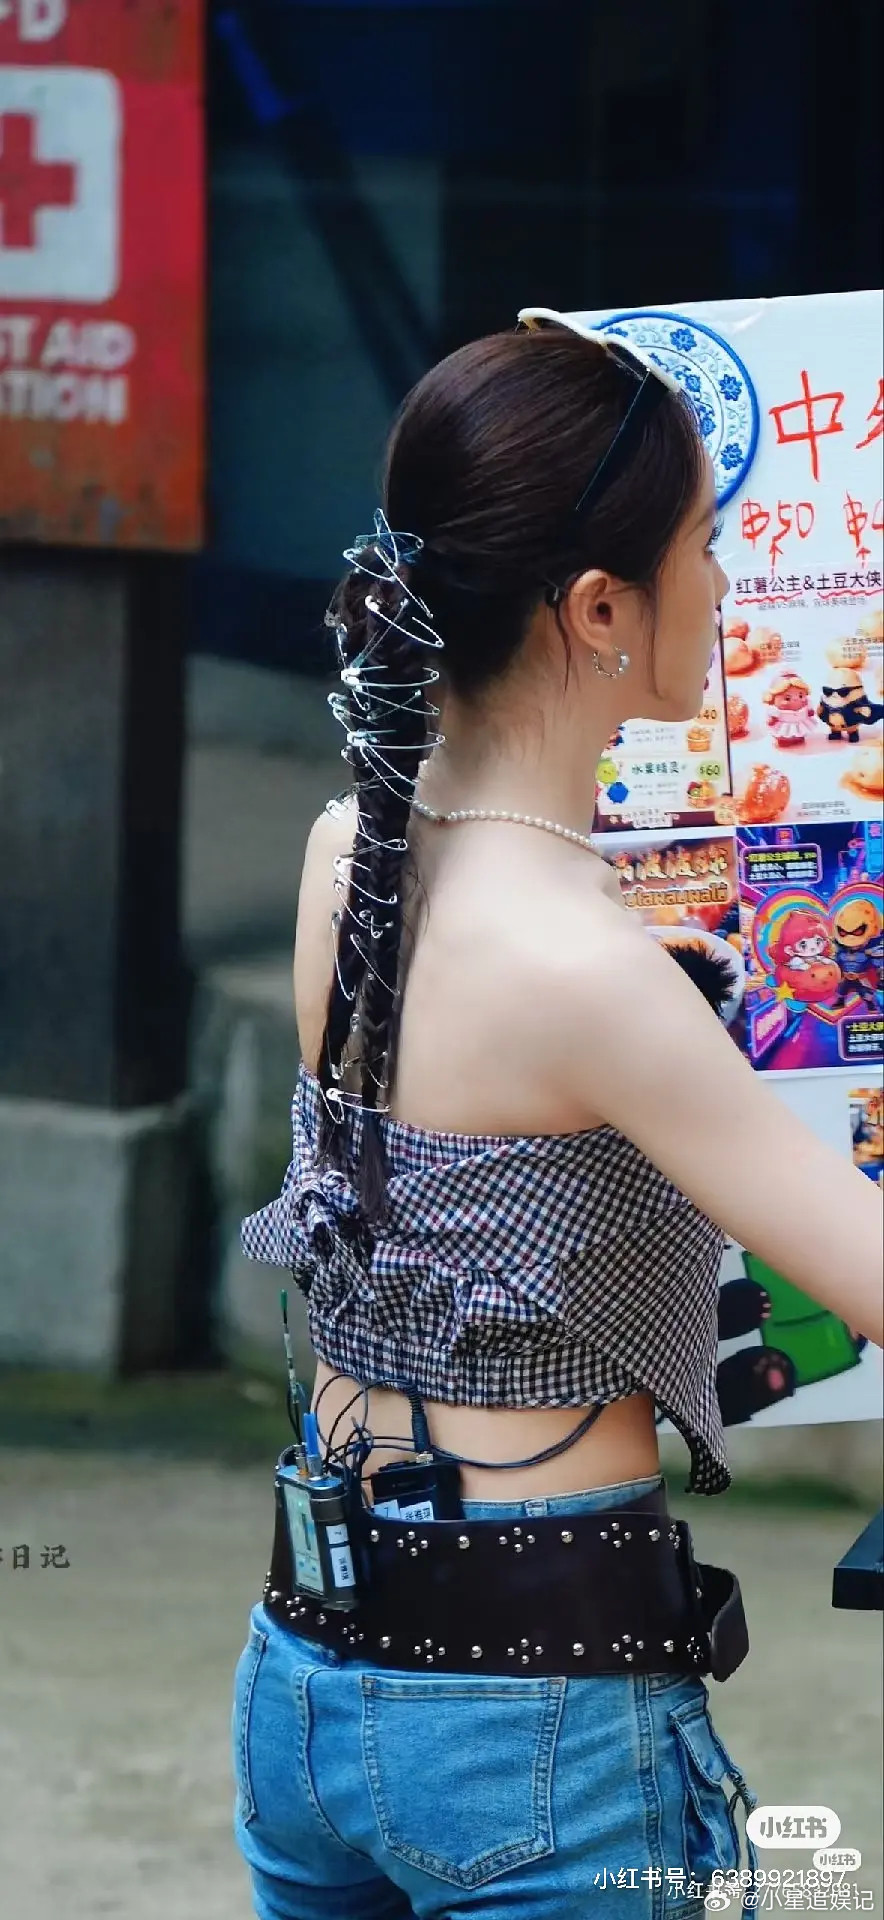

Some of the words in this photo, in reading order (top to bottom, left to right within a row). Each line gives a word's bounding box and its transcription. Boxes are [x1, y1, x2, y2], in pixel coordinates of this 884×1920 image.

[0, 315, 38, 363] T
[41, 319, 136, 370] AID
[0, 371, 127, 424] TION
[735, 570, 881, 594] 红薯公主&土豆大侠
